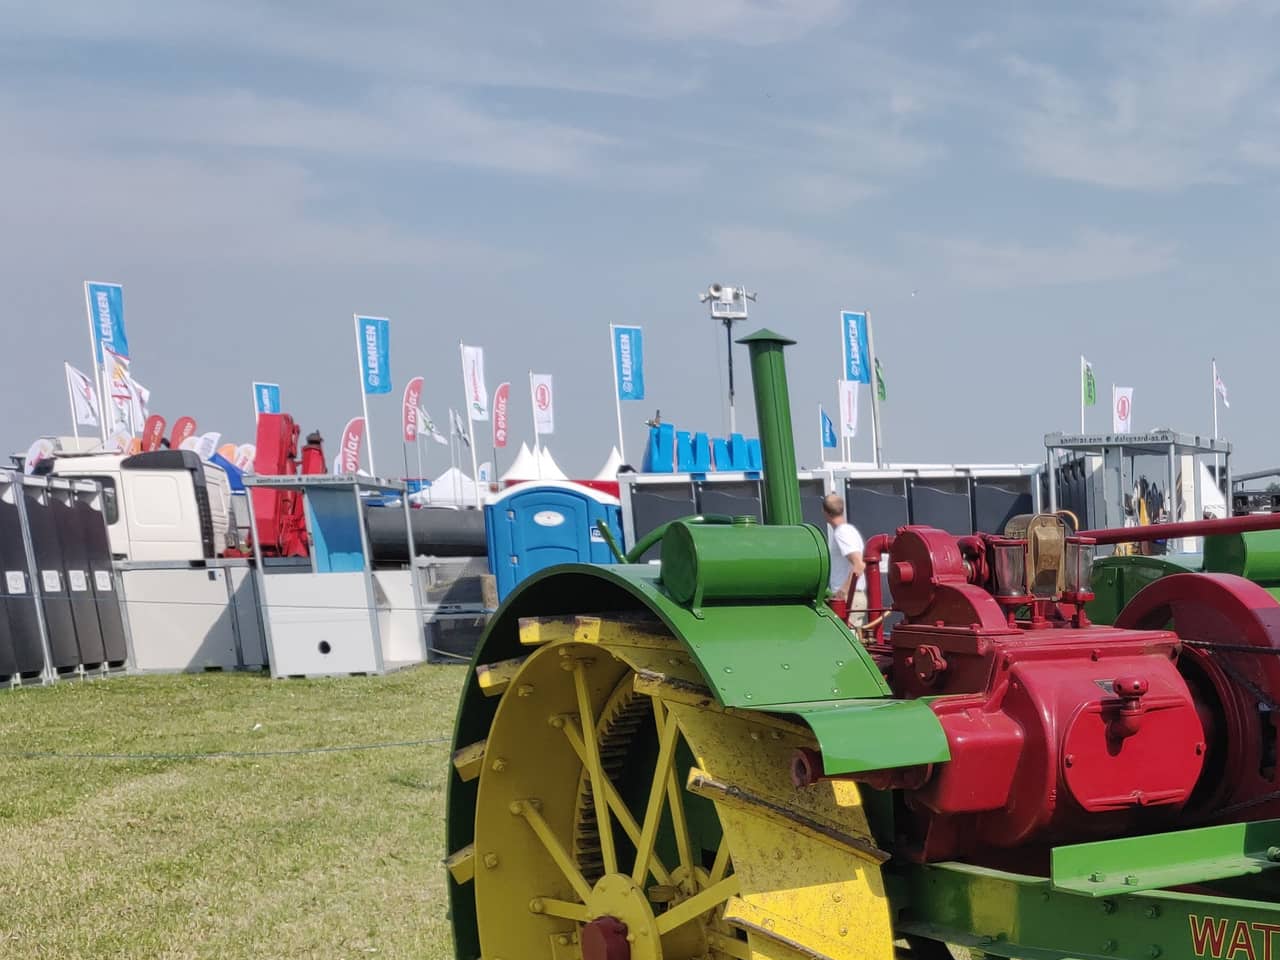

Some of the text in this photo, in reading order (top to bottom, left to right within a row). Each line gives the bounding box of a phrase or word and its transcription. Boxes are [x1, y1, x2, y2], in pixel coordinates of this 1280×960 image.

[96, 291, 114, 343] LEMKEN
[365, 325, 379, 375] LEMKEN
[620, 334, 632, 381] LEMKEN
[345, 433, 360, 473] ovlac
